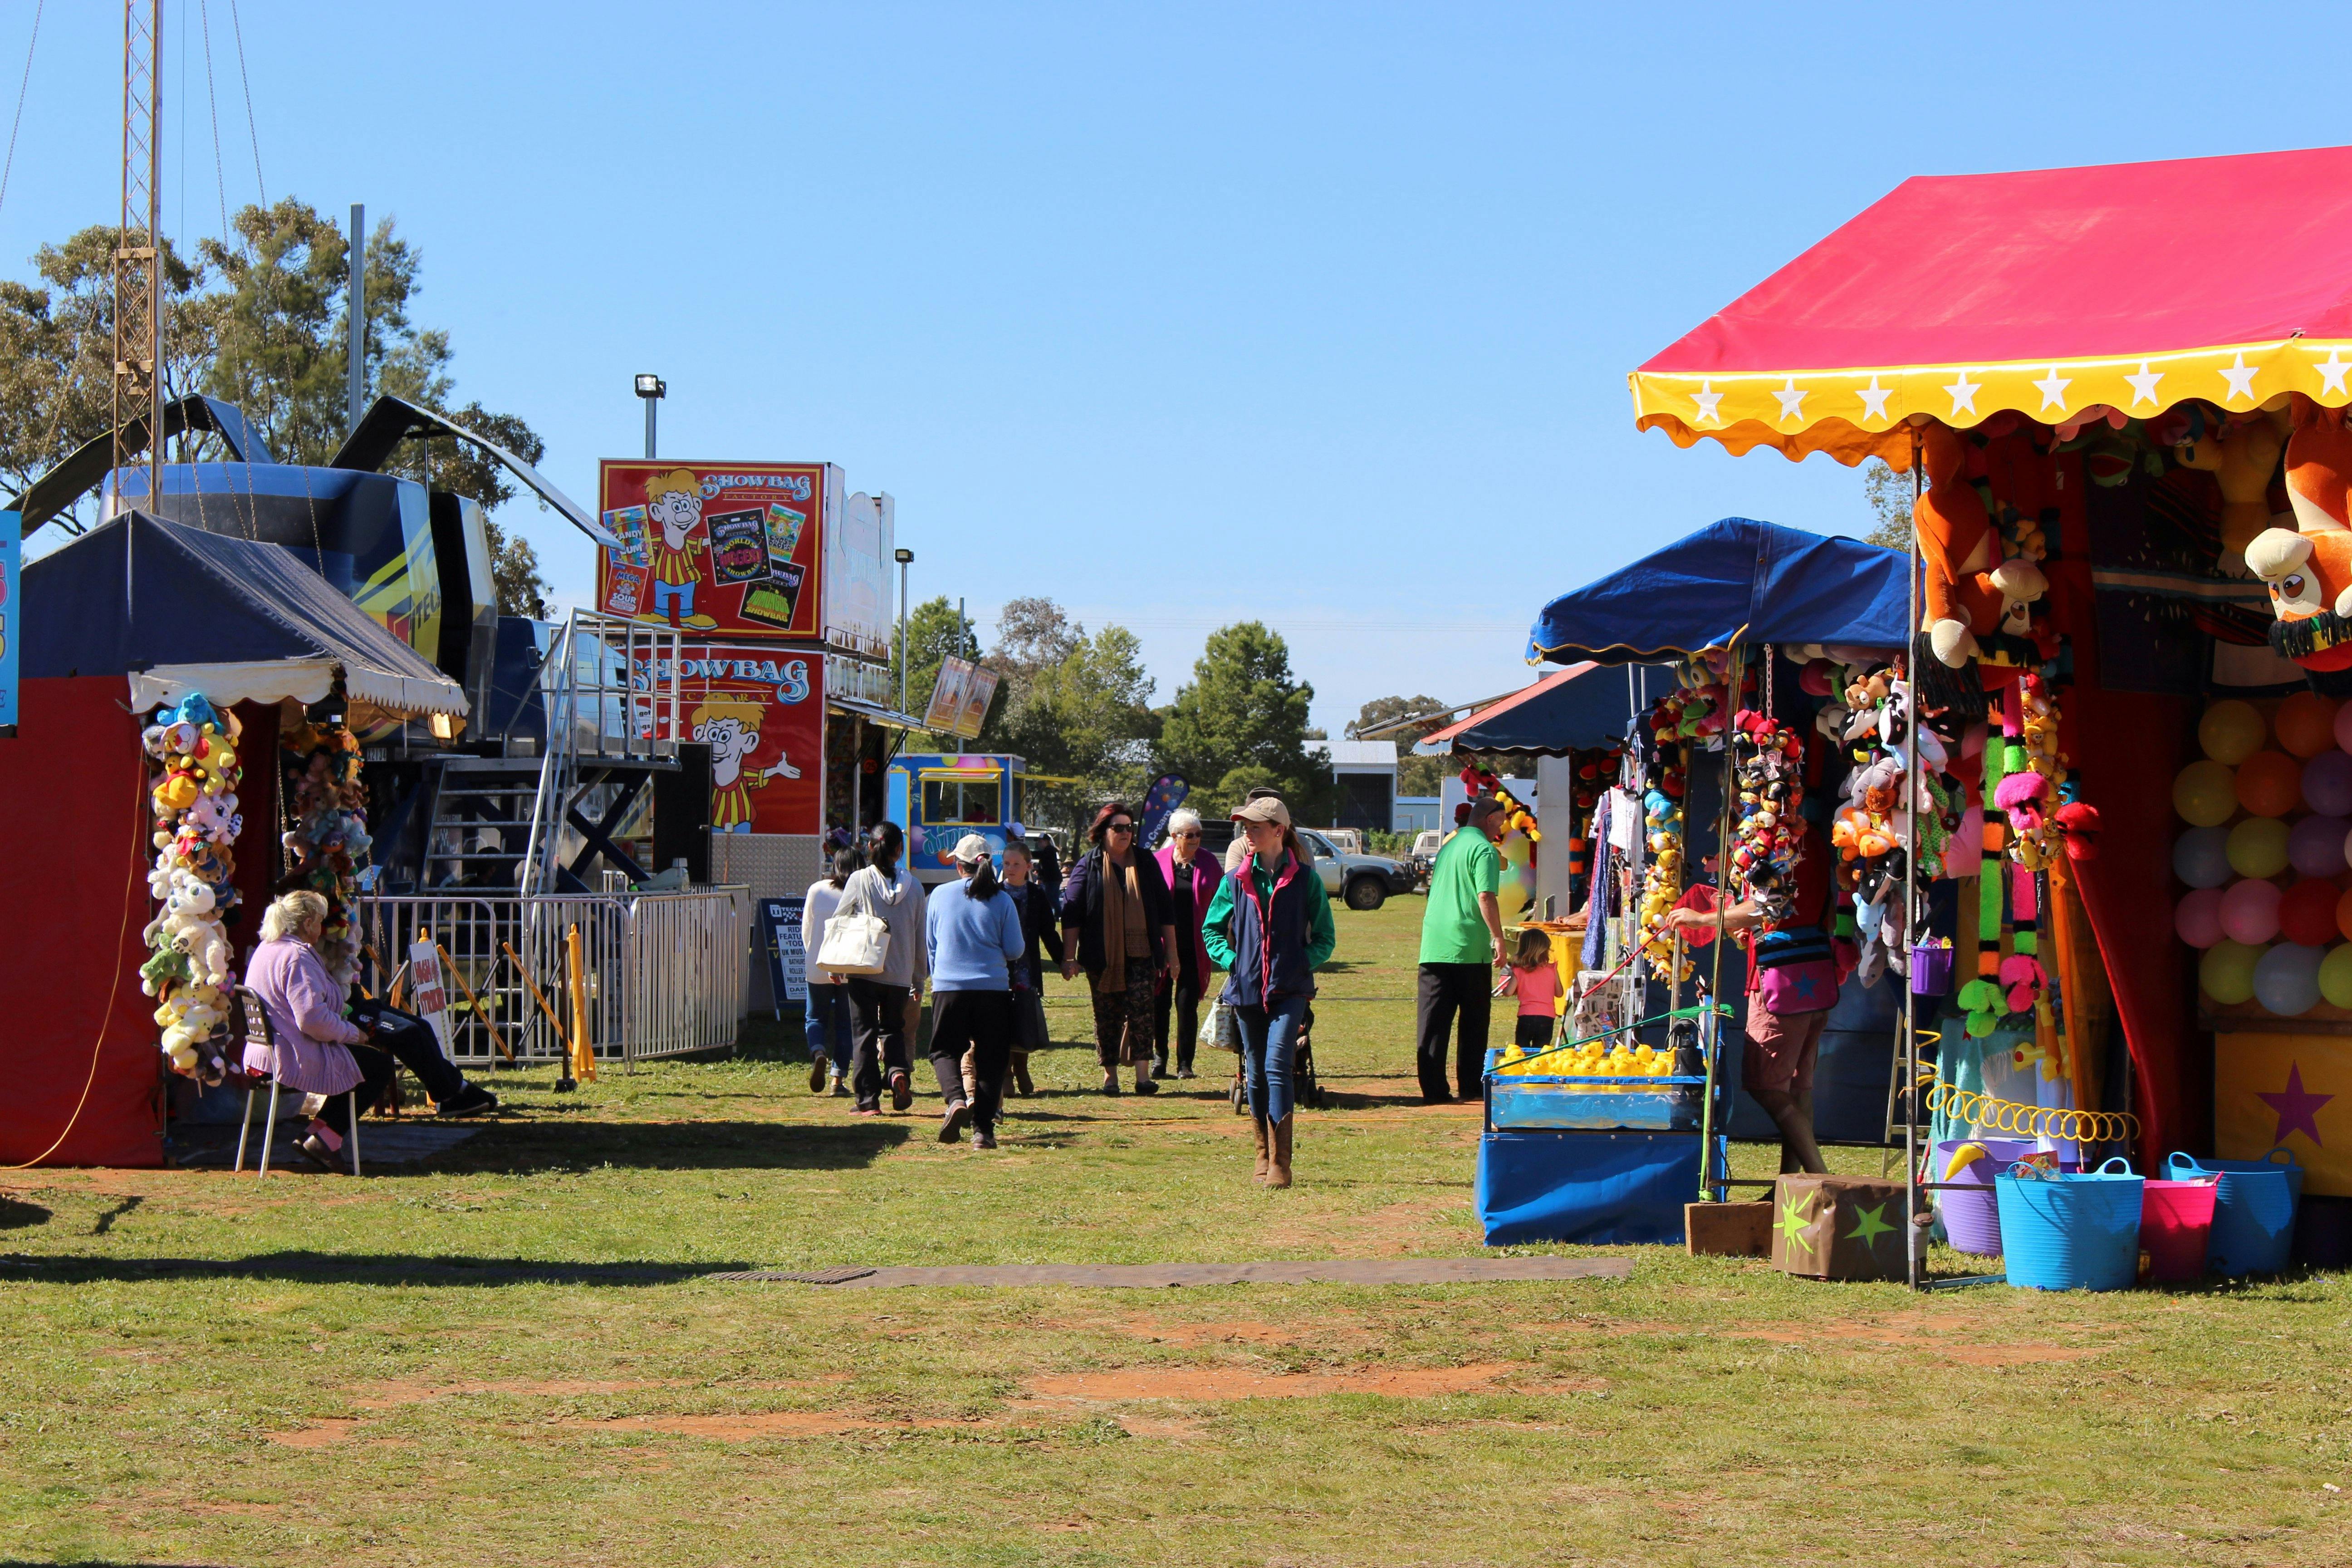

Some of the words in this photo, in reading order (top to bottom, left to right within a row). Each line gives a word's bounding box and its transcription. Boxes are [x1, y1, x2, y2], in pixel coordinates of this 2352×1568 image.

[698, 475, 811, 501] SHOWBAG
[614, 529, 643, 541] CANDY
[726, 563, 759, 576] SHOWBAG
[615, 571, 641, 585] MEGA
[772, 569, 799, 587] OWBAG
[612, 593, 637, 603] SOUR
[745, 607, 788, 622] SHOWBAG
